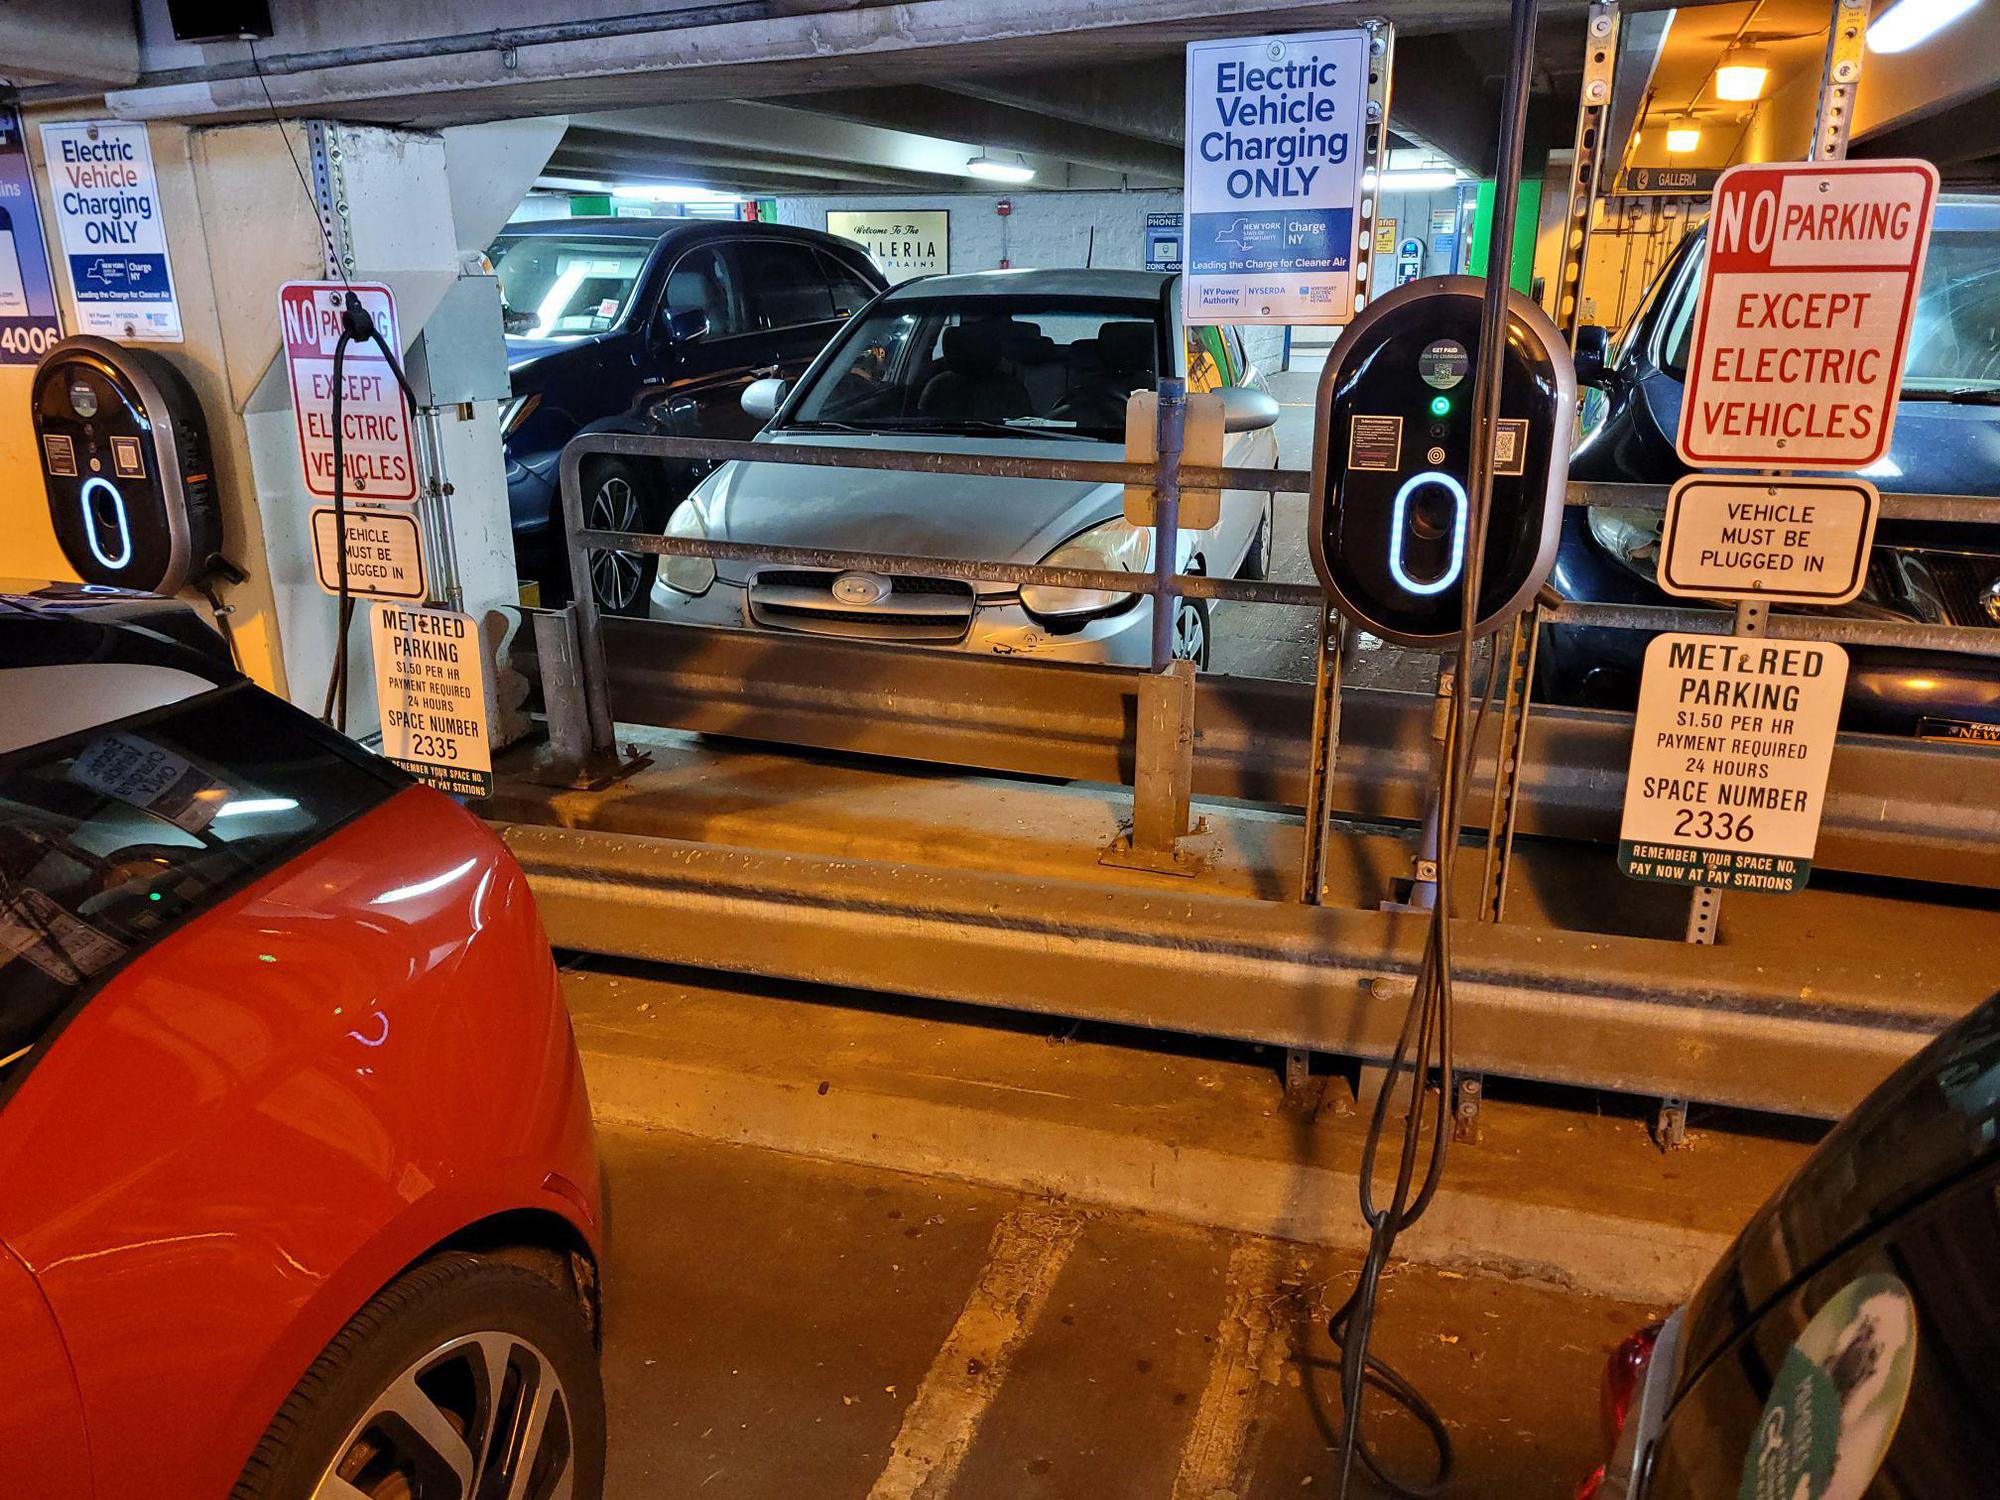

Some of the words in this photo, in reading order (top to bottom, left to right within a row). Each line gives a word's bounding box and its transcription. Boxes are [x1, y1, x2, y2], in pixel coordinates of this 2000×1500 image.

[1217, 56, 1337, 93] Electric
[1216, 91, 1335, 127] Vehicle
[62, 139, 134, 163] Electric
[1200, 128, 1348, 166] Charging
[66, 166, 138, 190] Vehicle
[1226, 165, 1319, 199] ONLY
[1658, 173, 1697, 187] GALLERIA
[63, 192, 152, 220] Charging
[84, 220, 138, 245] ONLY
[853, 224, 888, 235] Welcome
[889, 224, 901, 235] To
[903, 224, 919, 235] The
[1148, 218, 1176, 226] PHONE
[1243, 222, 1260, 230] NEW
[1261, 222, 1281, 230] YORK
[1288, 221, 1326, 235] Charge
[1716, 189, 1776, 254] NO
[1782, 201, 1912, 241] PARKING
[1288, 234, 1304, 244] NY
[129, 262, 152, 274] Charge
[1192, 259, 1227, 270] Leading
[1229, 259, 1244, 269] the
[1245, 258, 1278, 270] Charge
[1280, 257, 1293, 268] for
[1295, 257, 1330, 268] Cleaner
[1332, 256, 1347, 267] Air
[130, 272, 141, 281] NY
[1203, 288, 1215, 296] NY
[1216, 287, 1240, 296] Power
[1203, 296, 1240, 306] Authority
[1248, 286, 1286, 296] NYSERDA
[285, 299, 317, 346] NO
[1737, 293, 1871, 329] EXCEPT
[1712, 348, 1881, 384] ELECTRIC
[307, 413, 398, 441] ELCTRIC
[1703, 402, 1873, 439] VEHICLES
[1727, 503, 1815, 524] VEHICLE
[1720, 528, 1775, 547] MUST
[1784, 530, 1811, 548] BE
[378, 547, 392, 561] BE
[1700, 550, 1794, 571] PLUGGED
[1804, 555, 1825, 573] IN
[393, 566, 404, 580] IN
[382, 609, 465, 639] METERED
[394, 636, 459, 663] PARKING
[396, 661, 421, 676] $1.50
[426, 665, 443, 679] PER
[447, 668, 460, 681] HR
[389, 676, 426, 692] PAYMENT
[430, 681, 471, 699] REQUIRED
[1679, 678, 1801, 712] PARKING
[408, 695, 419, 707] 24
[423, 698, 454, 713] HOURS
[388, 710, 425, 730] SPACE
[430, 715, 479, 738] NUMBER
[1676, 711, 1723, 731] $1.50
[1731, 716, 1763, 734] PER
[1771, 718, 1795, 736] HR
[1960, 727, 2000, 740] NEW
[412, 733, 458, 760] 2335
[1657, 733, 1725, 754] PAYMENT
[1731, 738, 1808, 760] REQUIRED
[430, 766, 448, 778] YOUR
[449, 769, 470, 781] SPACE
[472, 773, 484, 783] NO.
[1686, 758, 1705, 774] 24
[1713, 761, 1769, 779] HOURS
[428, 778, 436, 789] AT
[437, 780, 451, 791] PAY
[453, 782, 486, 797] STATIONS
[1643, 777, 1708, 804] SPACE
[1718, 783, 1809, 813] NUMBER
[1674, 808, 1755, 842] 2336
[1632, 844, 1697, 863] REMEMBER
[1702, 852, 1732, 868] YOUR
[1736, 856, 1775, 872] SPACE
[1777, 858, 1797, 874] NO.
[1630, 862, 1653, 876] PAY
[1656, 864, 1685, 880] NOW
[1688, 867, 1704, 881] AT
[1707, 870, 1732, 886] PAY
[1734, 873, 1793, 892] STATIONS
